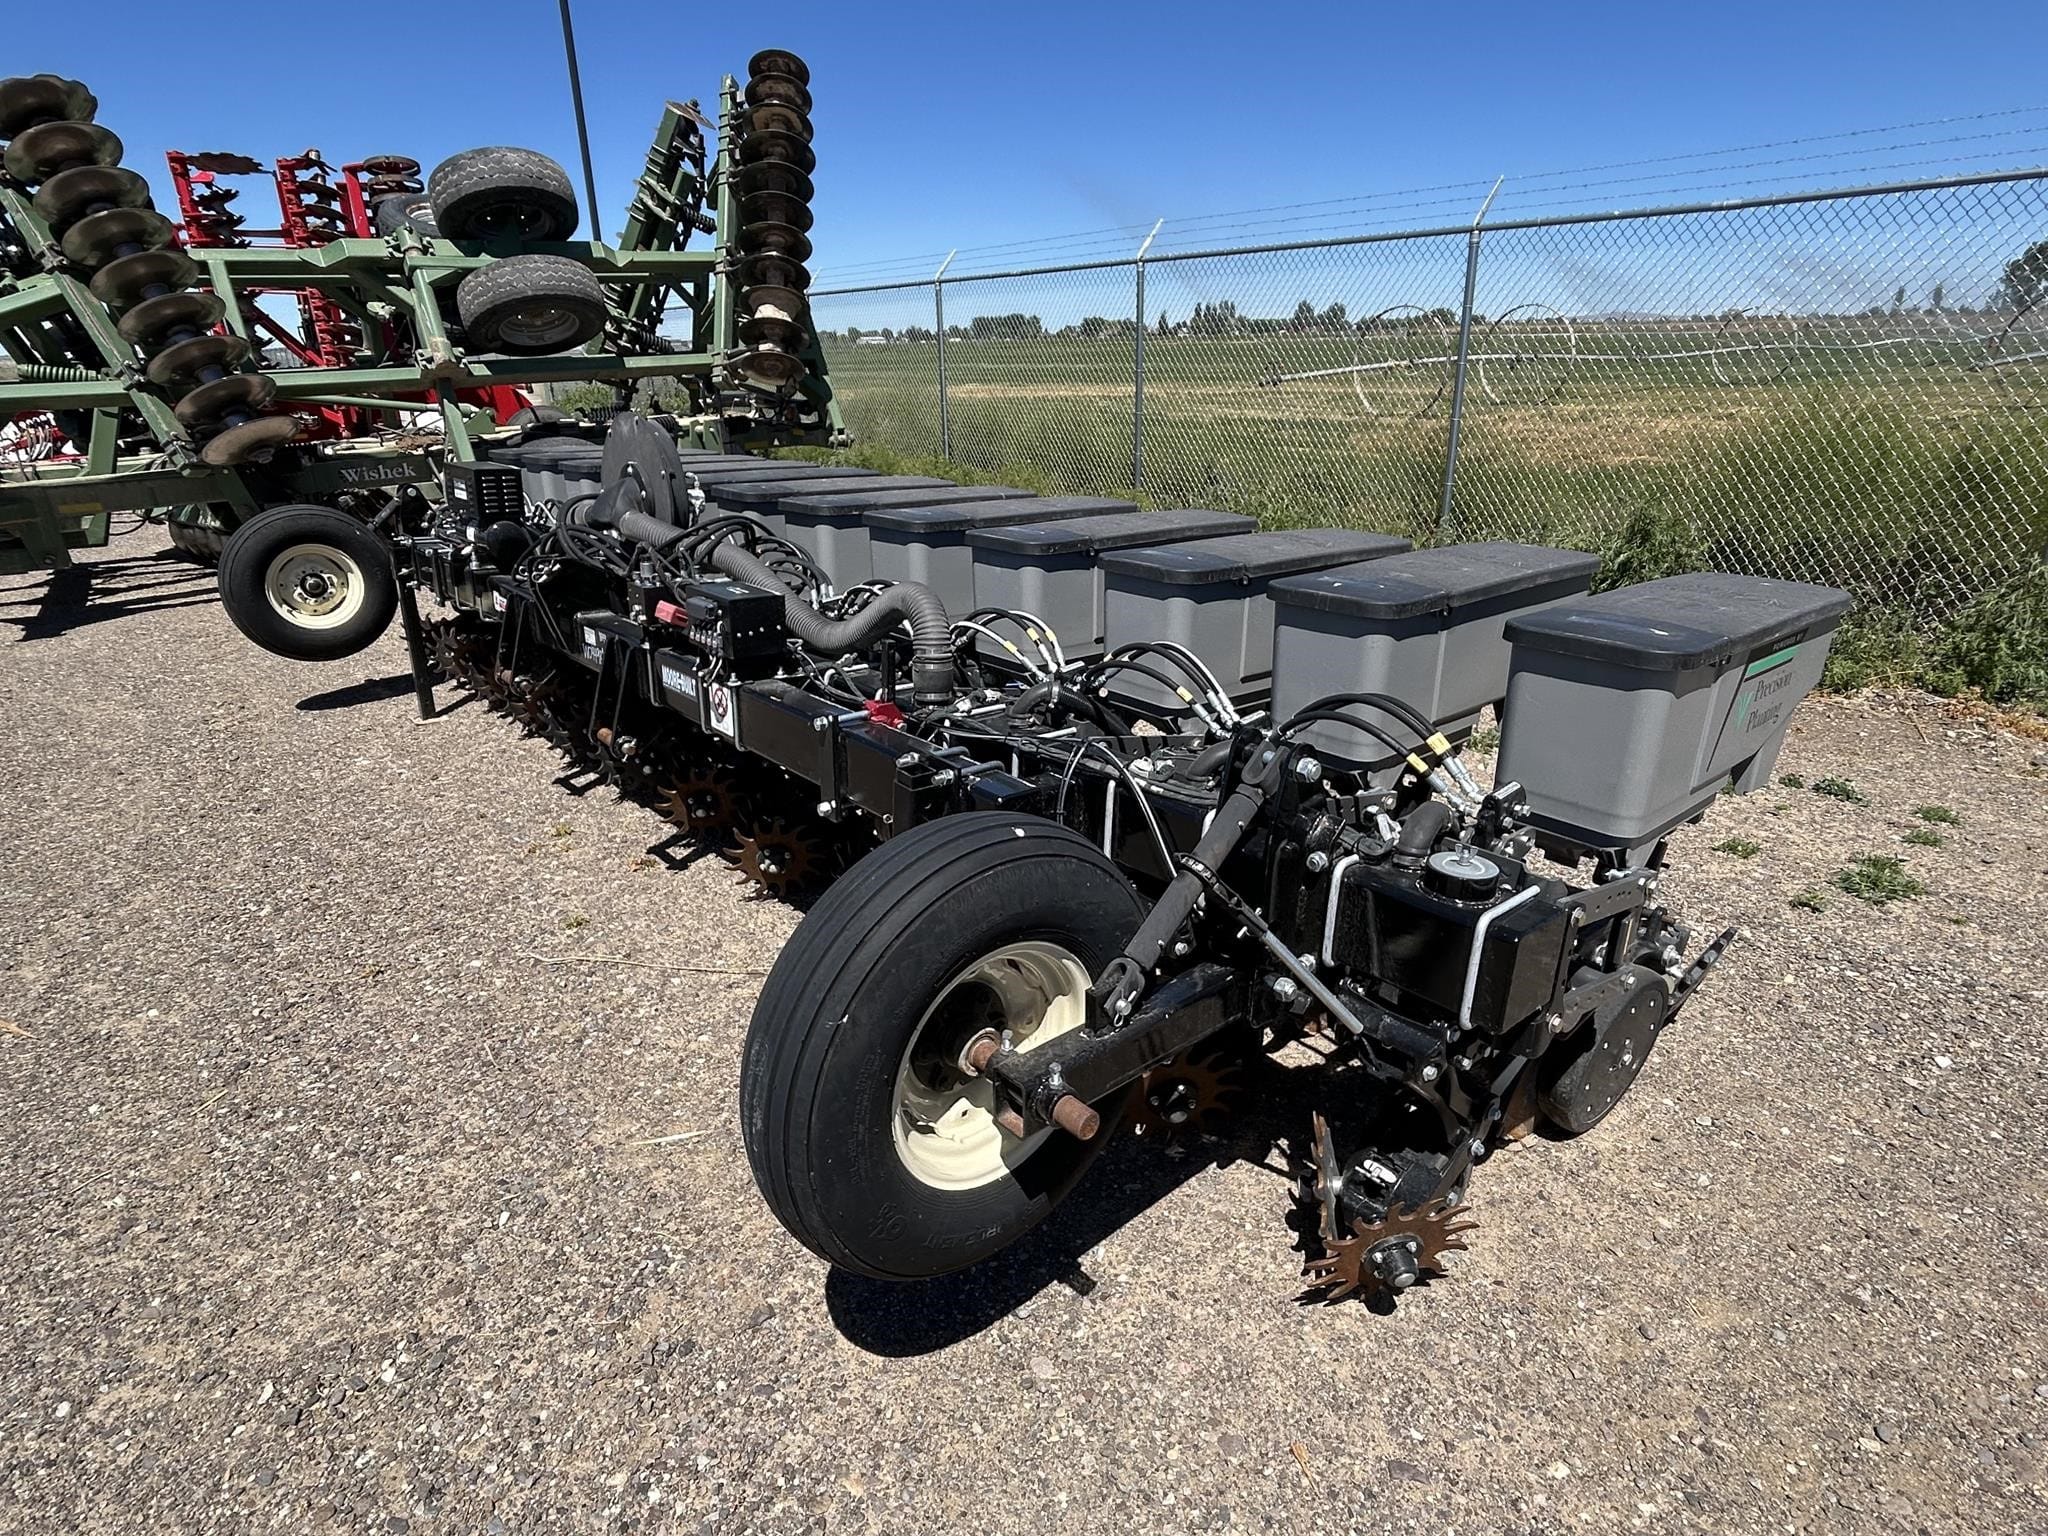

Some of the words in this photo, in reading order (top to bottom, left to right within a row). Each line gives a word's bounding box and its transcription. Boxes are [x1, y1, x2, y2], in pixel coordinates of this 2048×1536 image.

[340, 463, 417, 482] Wishek
[1754, 669, 1793, 702] Precision
[1745, 702, 1783, 733] Planting
